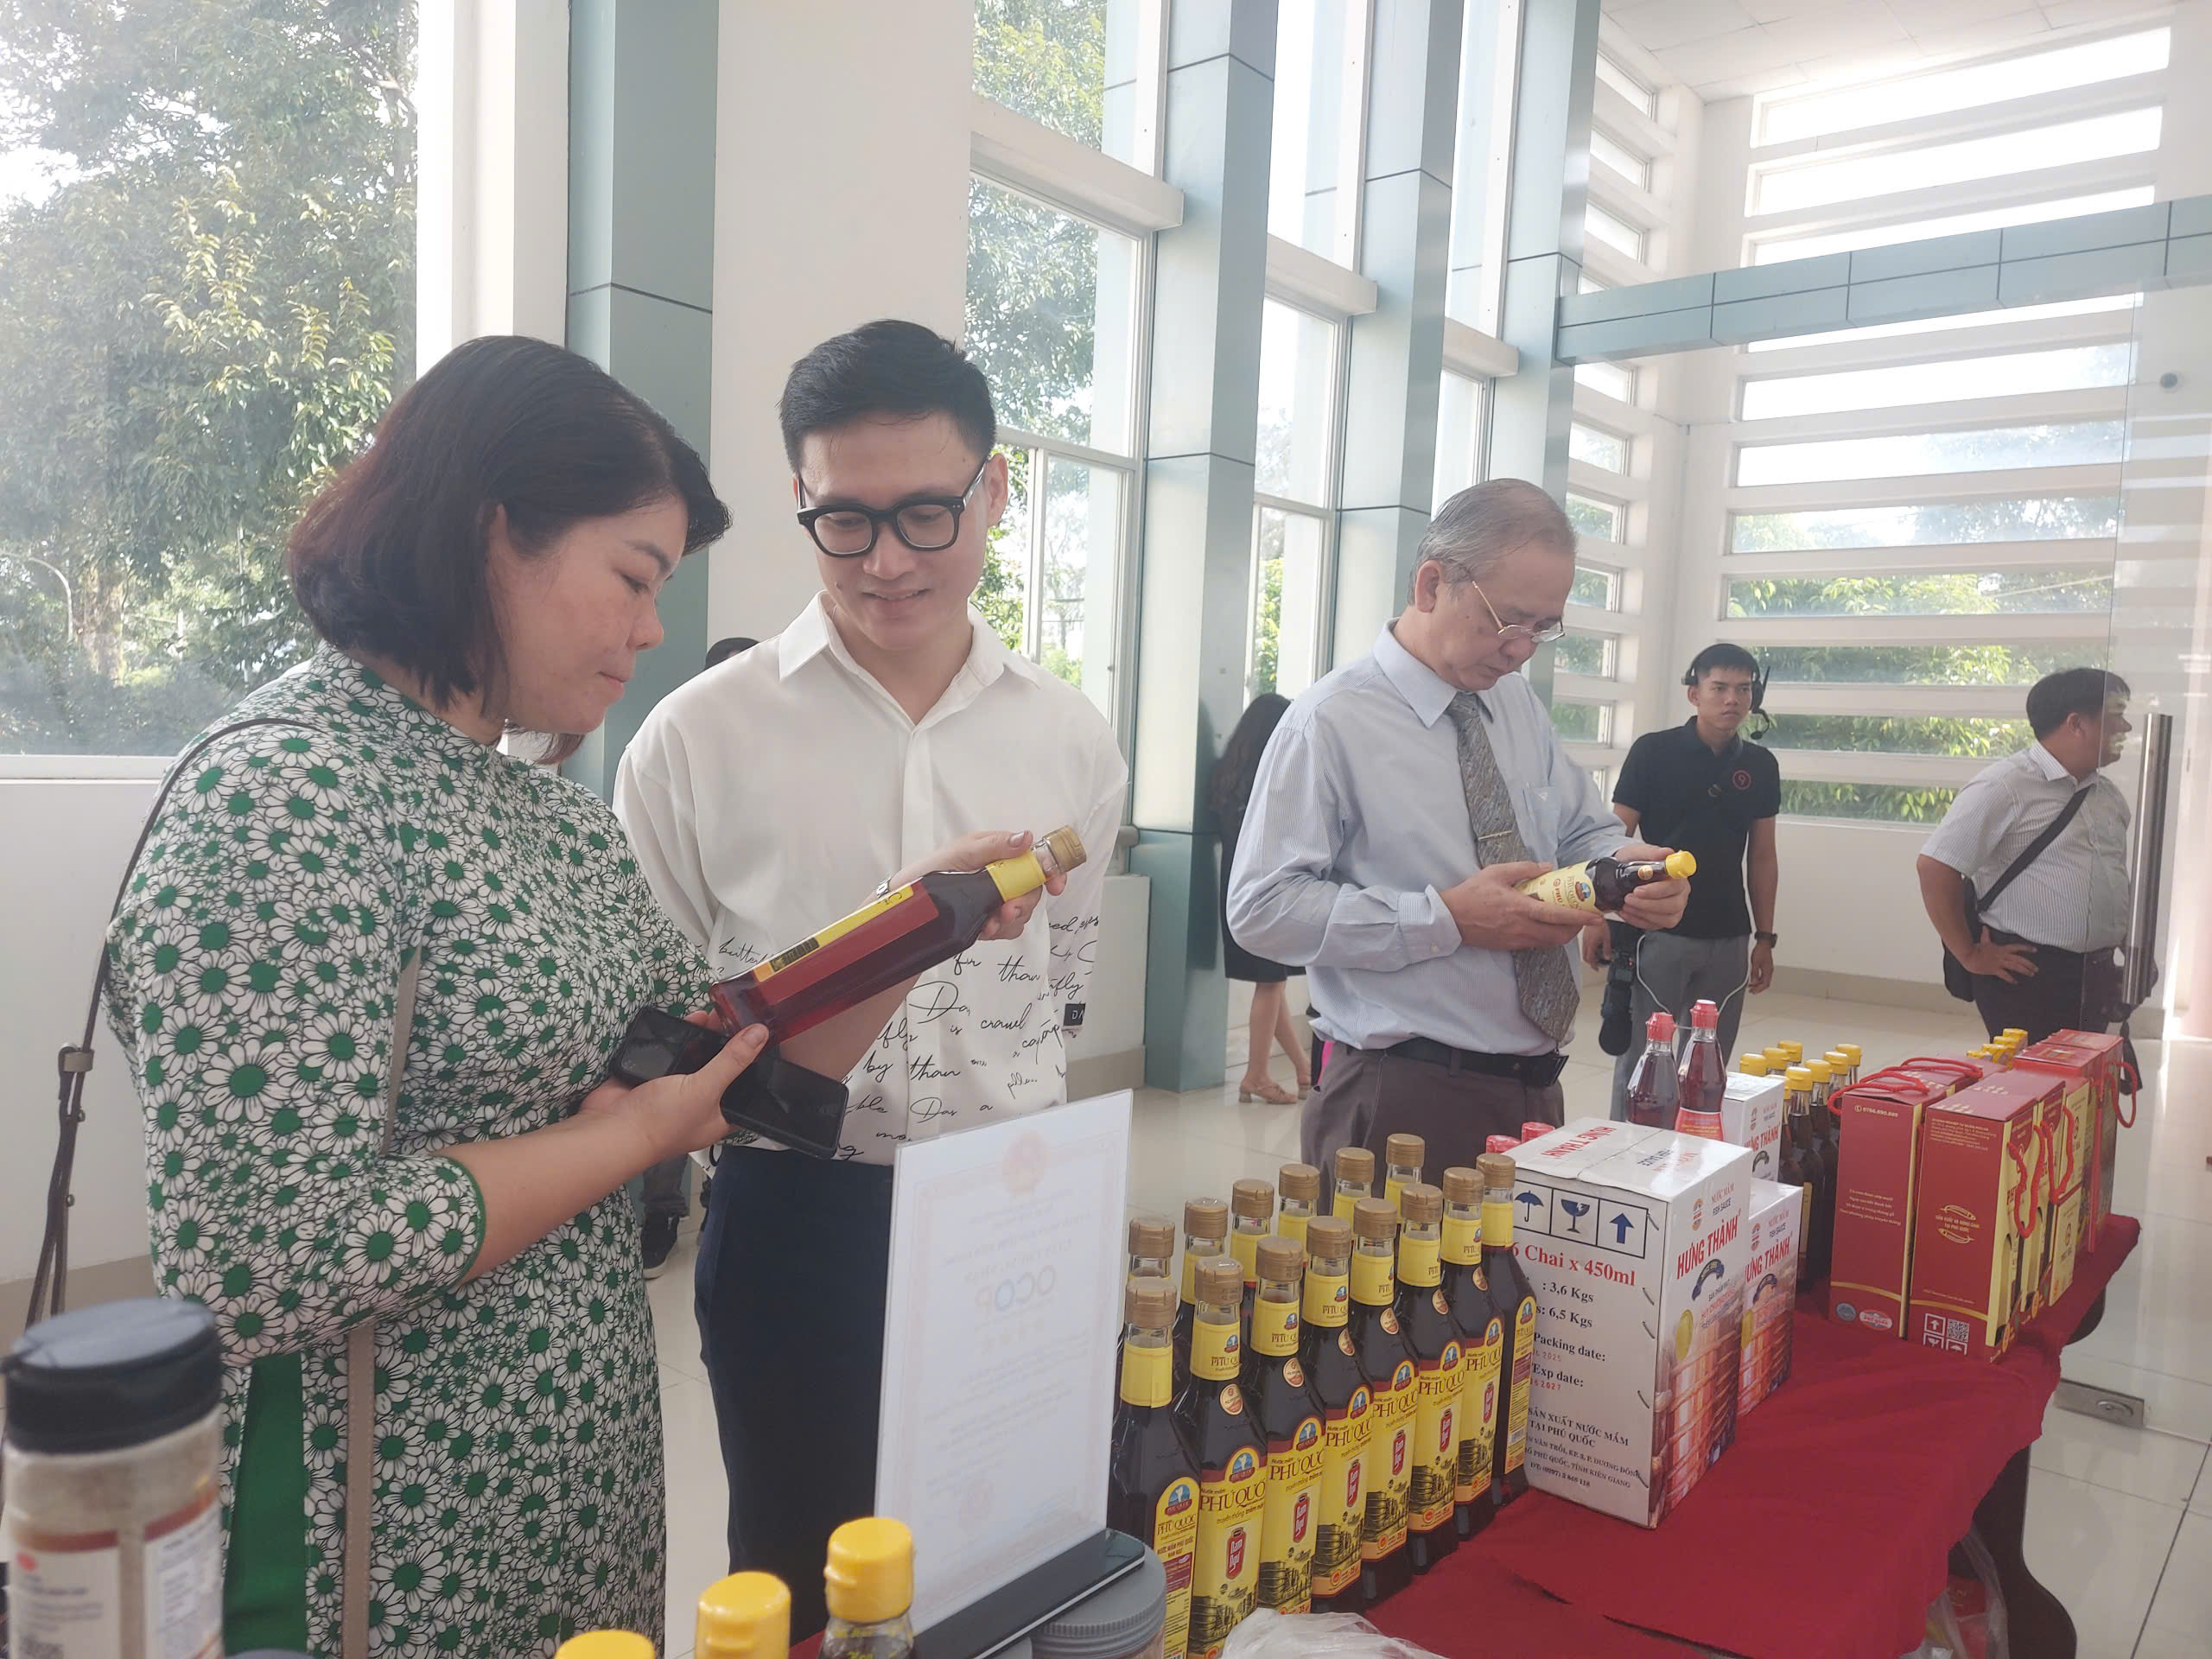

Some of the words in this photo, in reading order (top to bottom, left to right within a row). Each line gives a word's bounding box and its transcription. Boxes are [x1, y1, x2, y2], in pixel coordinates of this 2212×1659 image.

[1525, 1244, 1564, 1268] Chai
[1569, 1259, 1580, 1271] x
[1584, 1260, 1635, 1287] 450ml
[1676, 1239, 1705, 1280] HƯNG
[1550, 1282, 1567, 1296] 3,6
[1571, 1287, 1593, 1303] Kgs
[1549, 1307, 1566, 1320] 6,5
[1570, 1312, 1592, 1328] Kgs
[1578, 1345, 1605, 1362] date:
[1556, 1370, 1584, 1387] date:
[1528, 1407, 1546, 1419] SẢN
[1548, 1413, 1573, 1428] XUẤT
[1575, 1421, 1602, 1438] NƯỚC
[1604, 1432, 1629, 1446] MẮM
[1529, 1420, 1545, 1432] TẠI
[1548, 1427, 1567, 1438] PHÚ
[1568, 1433, 1596, 1448] QUỐC
